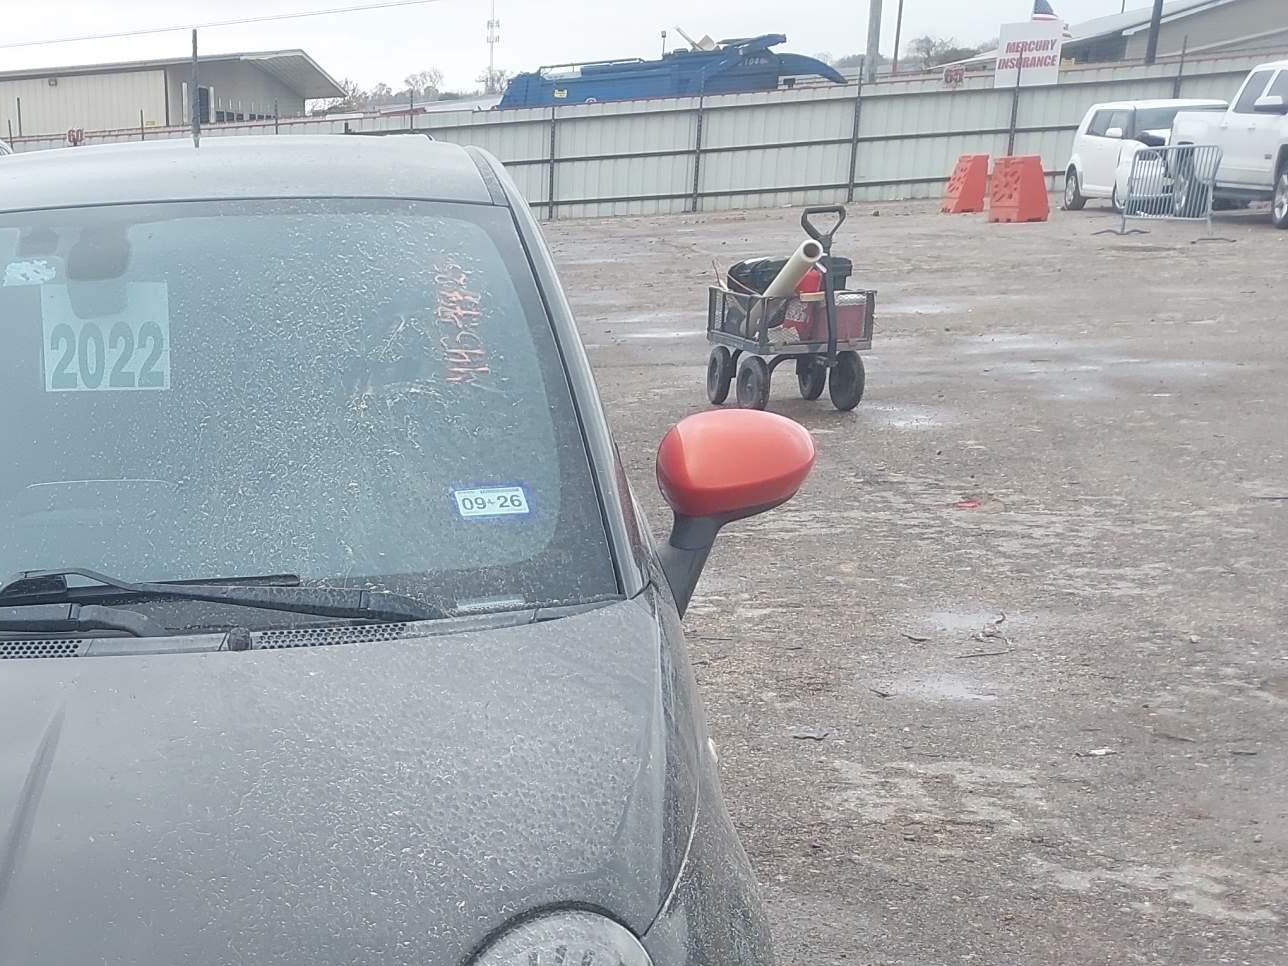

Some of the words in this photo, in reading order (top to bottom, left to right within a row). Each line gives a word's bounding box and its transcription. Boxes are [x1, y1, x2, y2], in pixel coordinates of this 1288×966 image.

[1005, 39, 1057, 54] MERCURY
[997, 55, 1058, 71] INSURANCE
[50, 321, 165, 389] 2022
[462, 497, 487, 511] 09
[497, 494, 523, 509] 26
